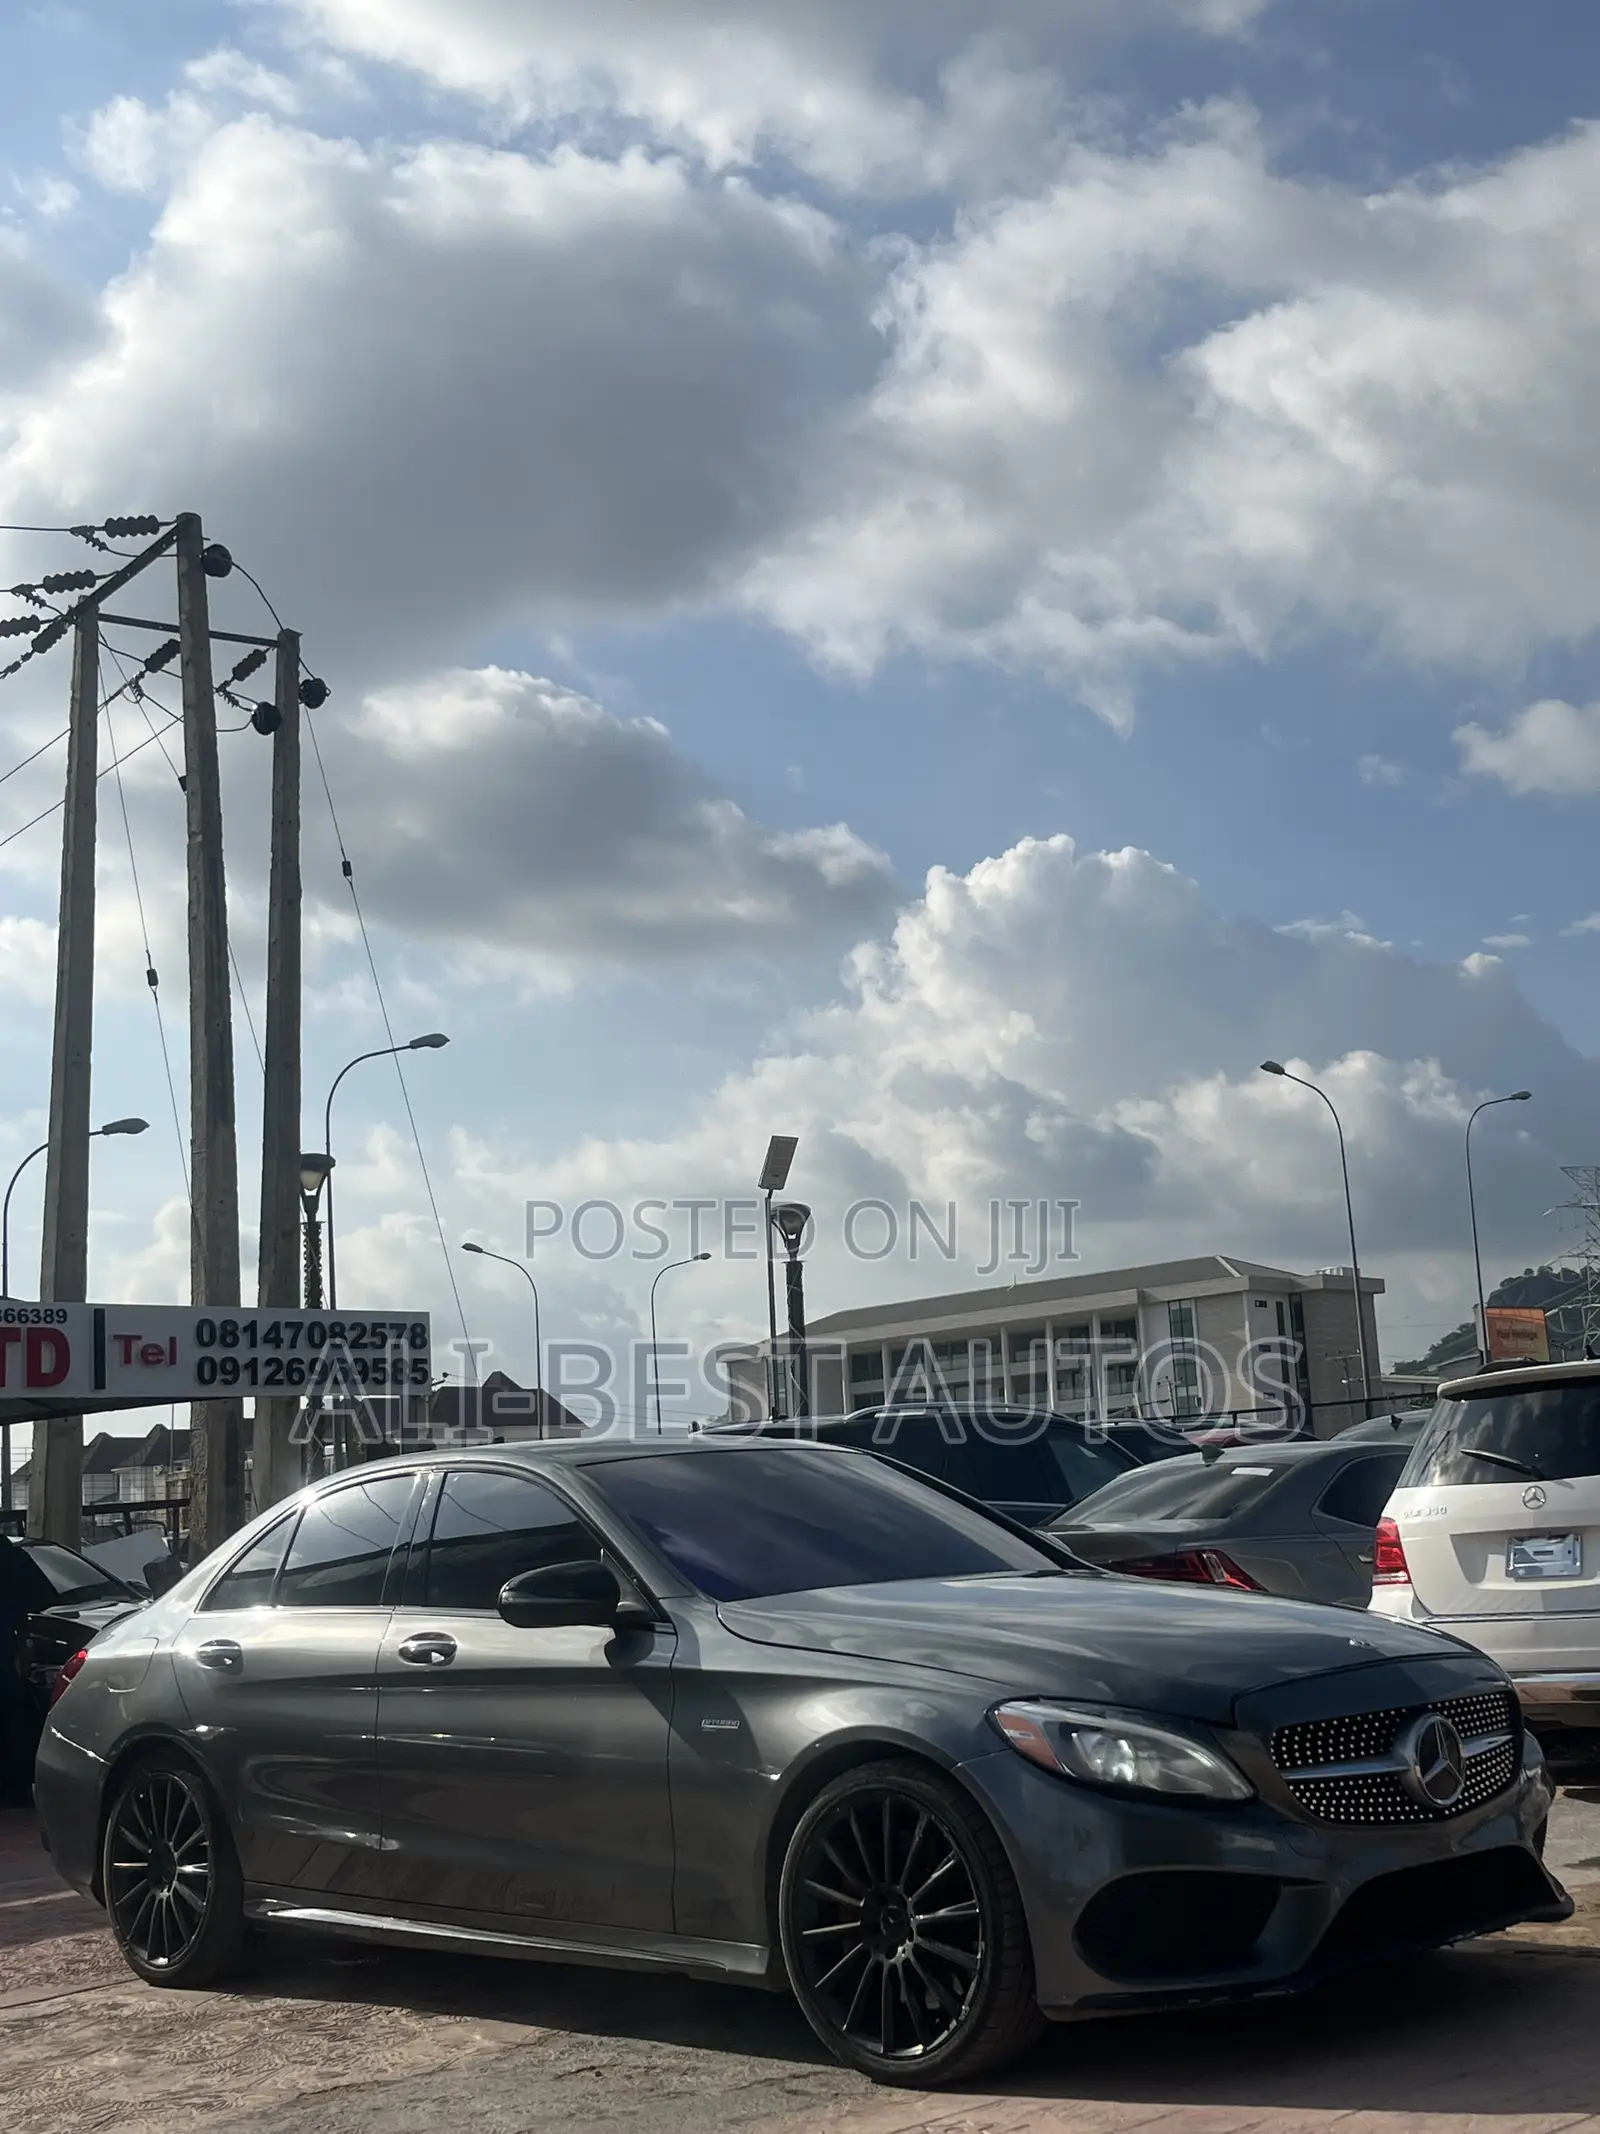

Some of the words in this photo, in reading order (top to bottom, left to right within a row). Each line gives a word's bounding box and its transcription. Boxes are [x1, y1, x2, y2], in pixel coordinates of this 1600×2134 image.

[0, 1308, 68, 1324] 66389
[113, 1334, 178, 1366] Tel
[196, 1318, 427, 1350] 08147082578
